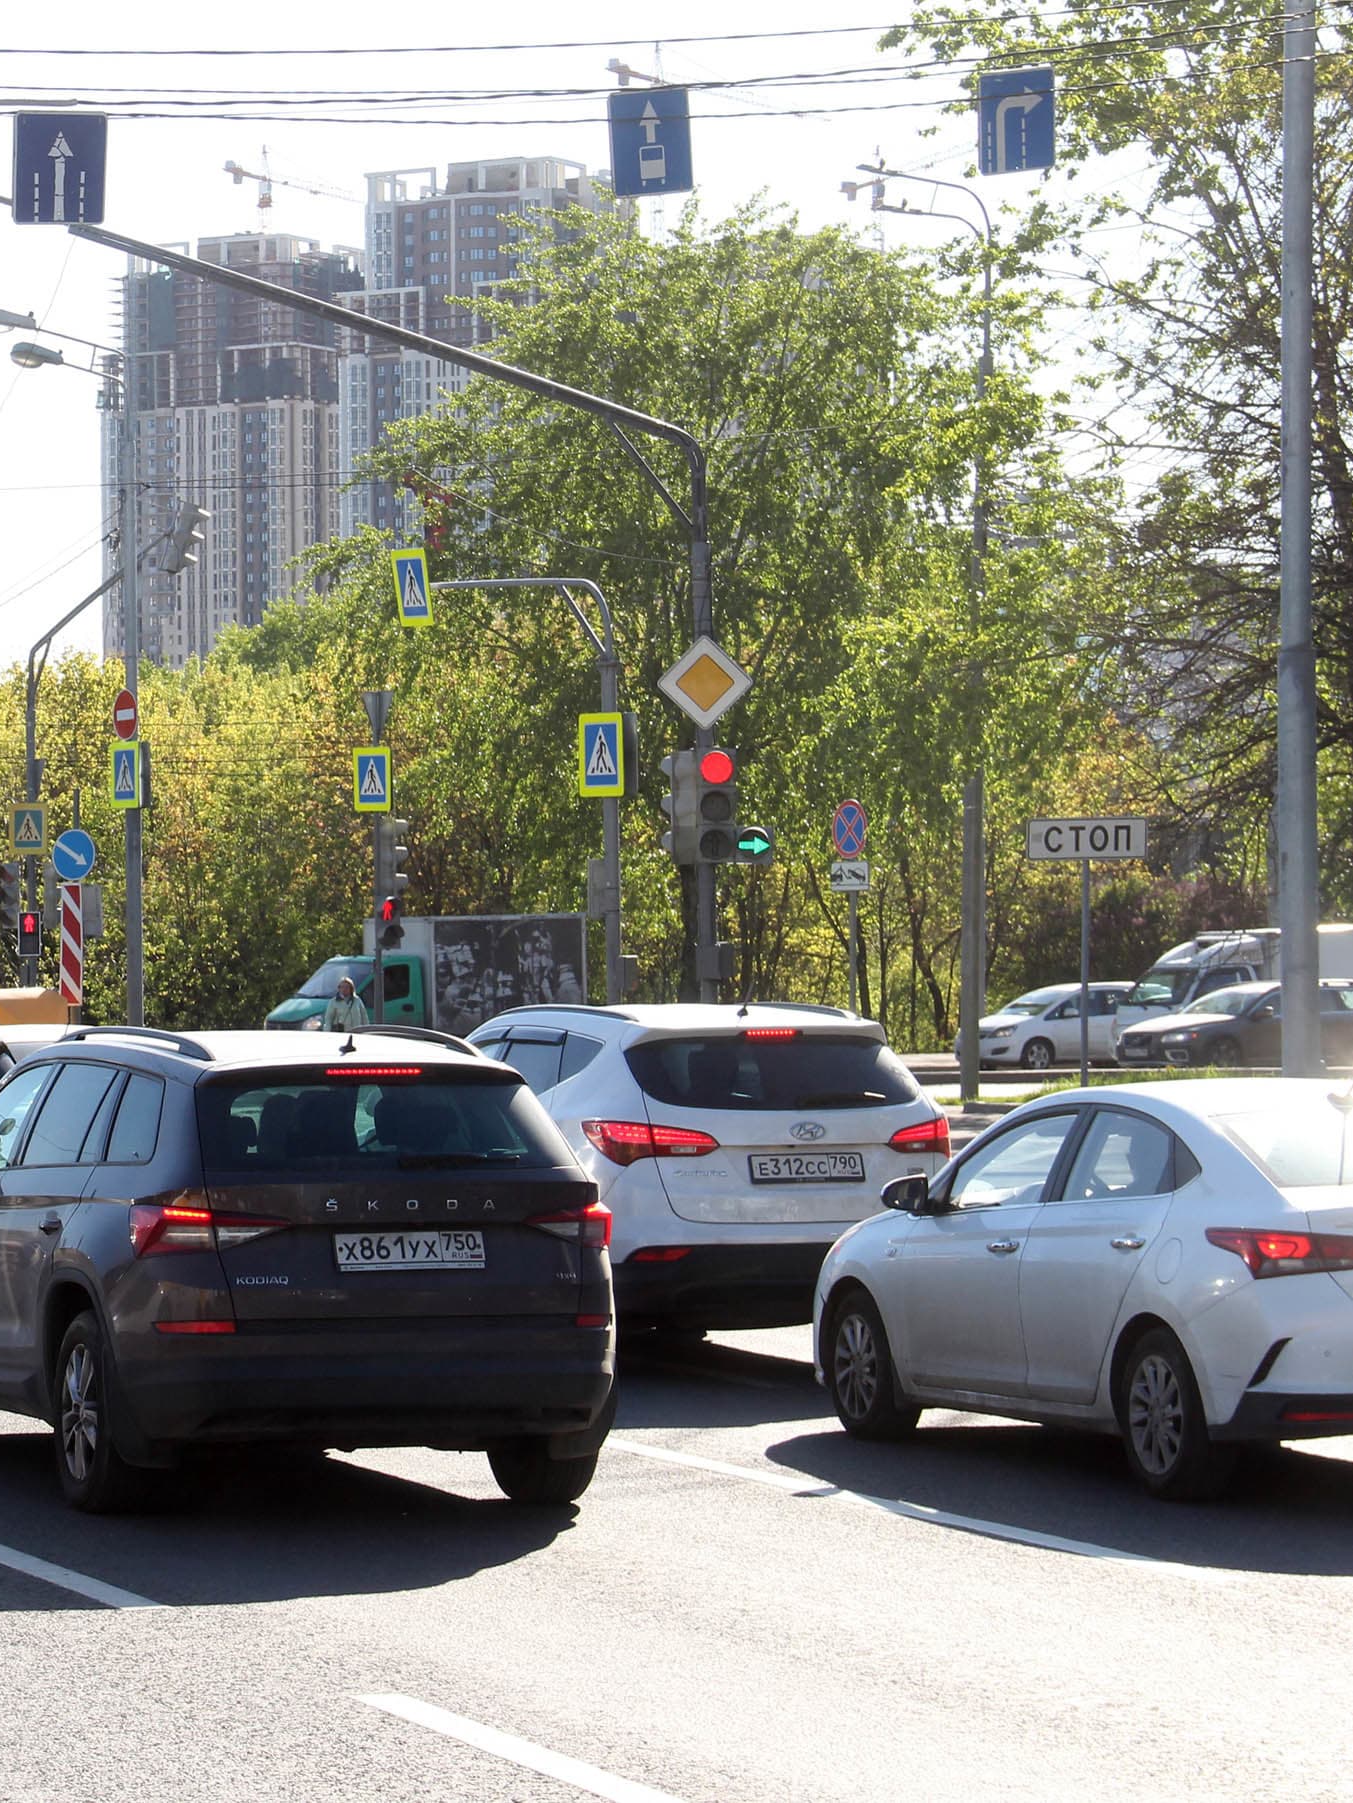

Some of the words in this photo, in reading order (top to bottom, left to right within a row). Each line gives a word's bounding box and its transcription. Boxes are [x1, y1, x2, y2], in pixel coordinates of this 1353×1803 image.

[1044, 825, 1131, 853] СТОП
[759, 1158, 828, 1176] Е312СС
[830, 1156, 857, 1169] 790
[326, 1198, 495, 1212] ŠKODA
[343, 1236, 438, 1260] Х861УХ
[441, 1233, 477, 1251] 750
[451, 1251, 470, 1259] RUS
[236, 1275, 289, 1285] KODIAQ
